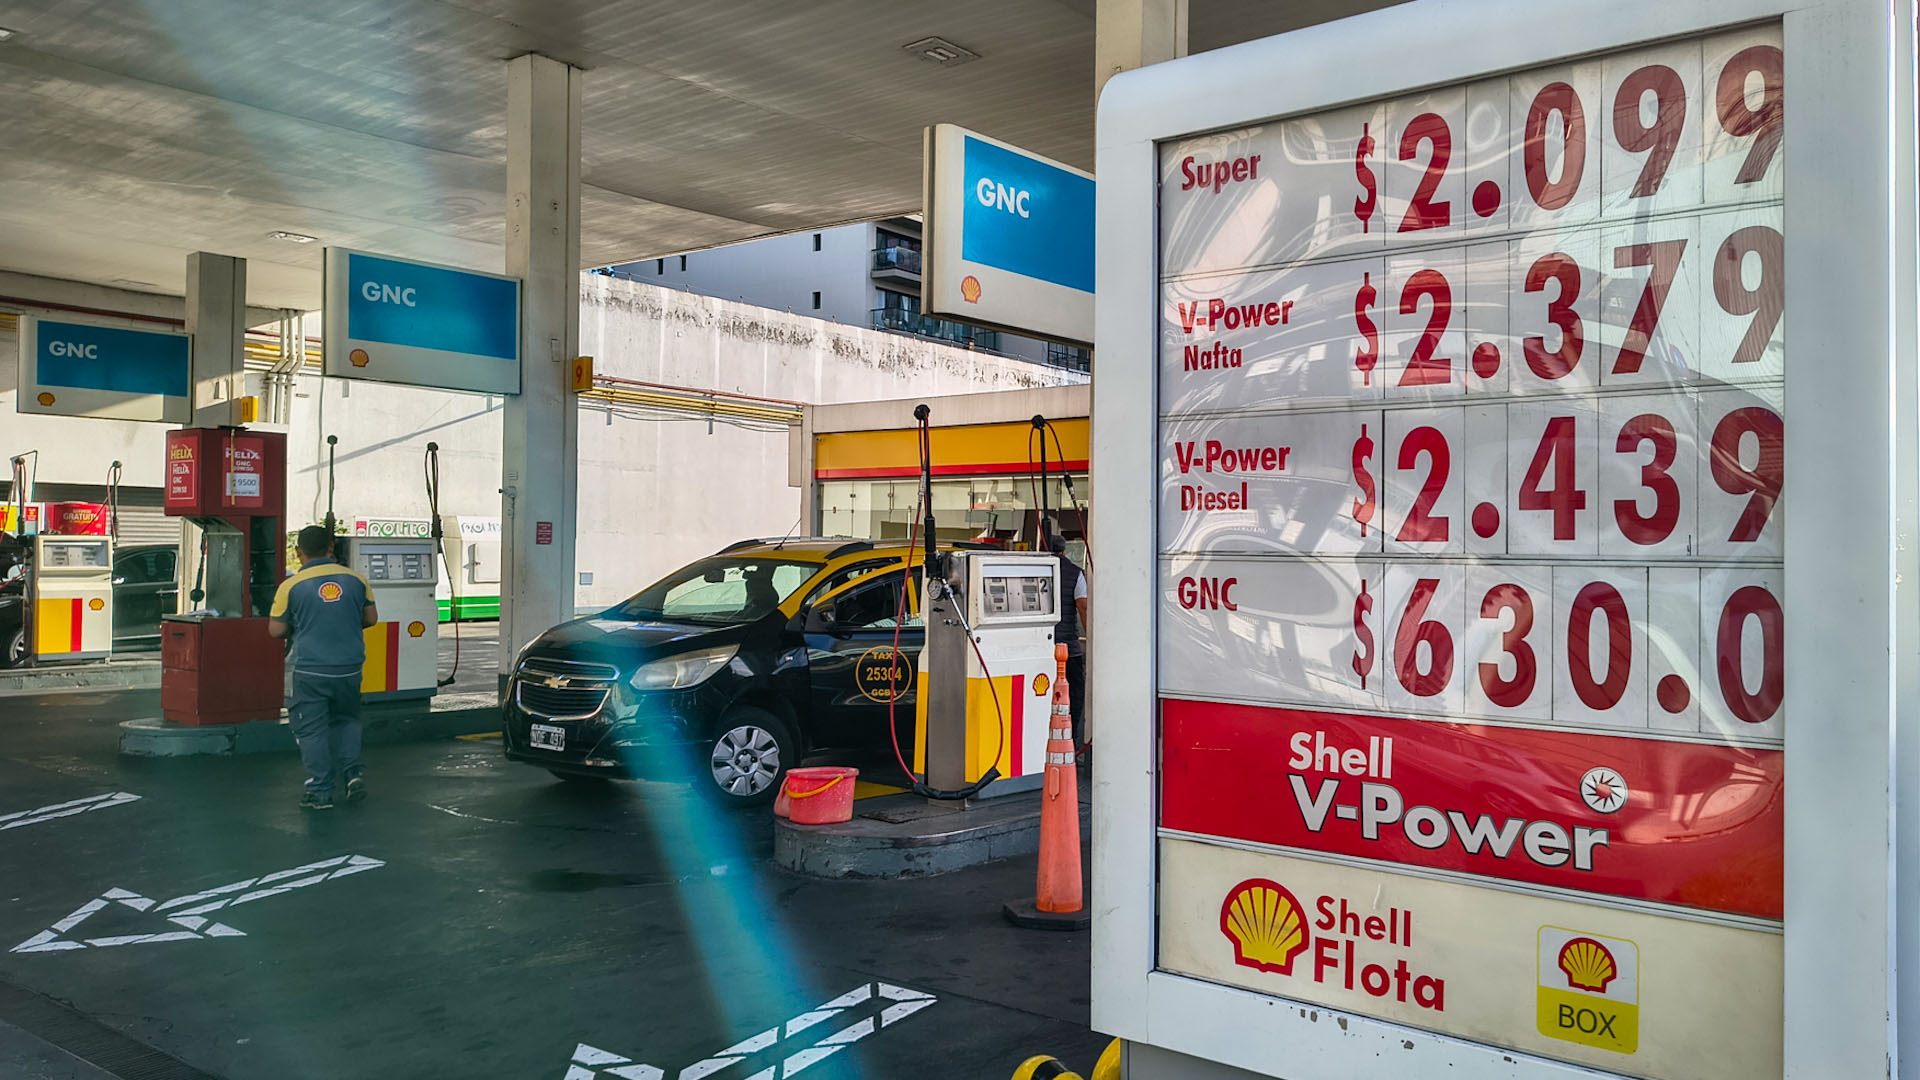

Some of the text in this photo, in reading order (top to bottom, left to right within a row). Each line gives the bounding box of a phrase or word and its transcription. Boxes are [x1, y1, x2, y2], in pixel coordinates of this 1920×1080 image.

[1181, 155, 1261, 194] Super
[977, 177, 1030, 219] GNC
[362, 281, 417, 307] GNC
[1178, 297, 1294, 335] V-Power
[49, 341, 98, 360] GNC
[1183, 342, 1243, 372] Nafta
[171, 446, 193, 460] HELIX
[225, 449, 261, 460] HELIX
[1174, 440, 1291, 475] V-Power
[1181, 482, 1248, 513] Diesel
[1039, 578, 1048, 593] 2
[1178, 576, 1238, 611] GNC
[872, 651, 895, 660] TAX
[866, 666, 902, 681] 25304
[1289, 731, 1393, 779] Shell
[1288, 773, 1610, 871] V-Power
[1315, 895, 1412, 948] Shell
[1312, 940, 1446, 1013] Flota
[1557, 1003, 1617, 1041] BOX
